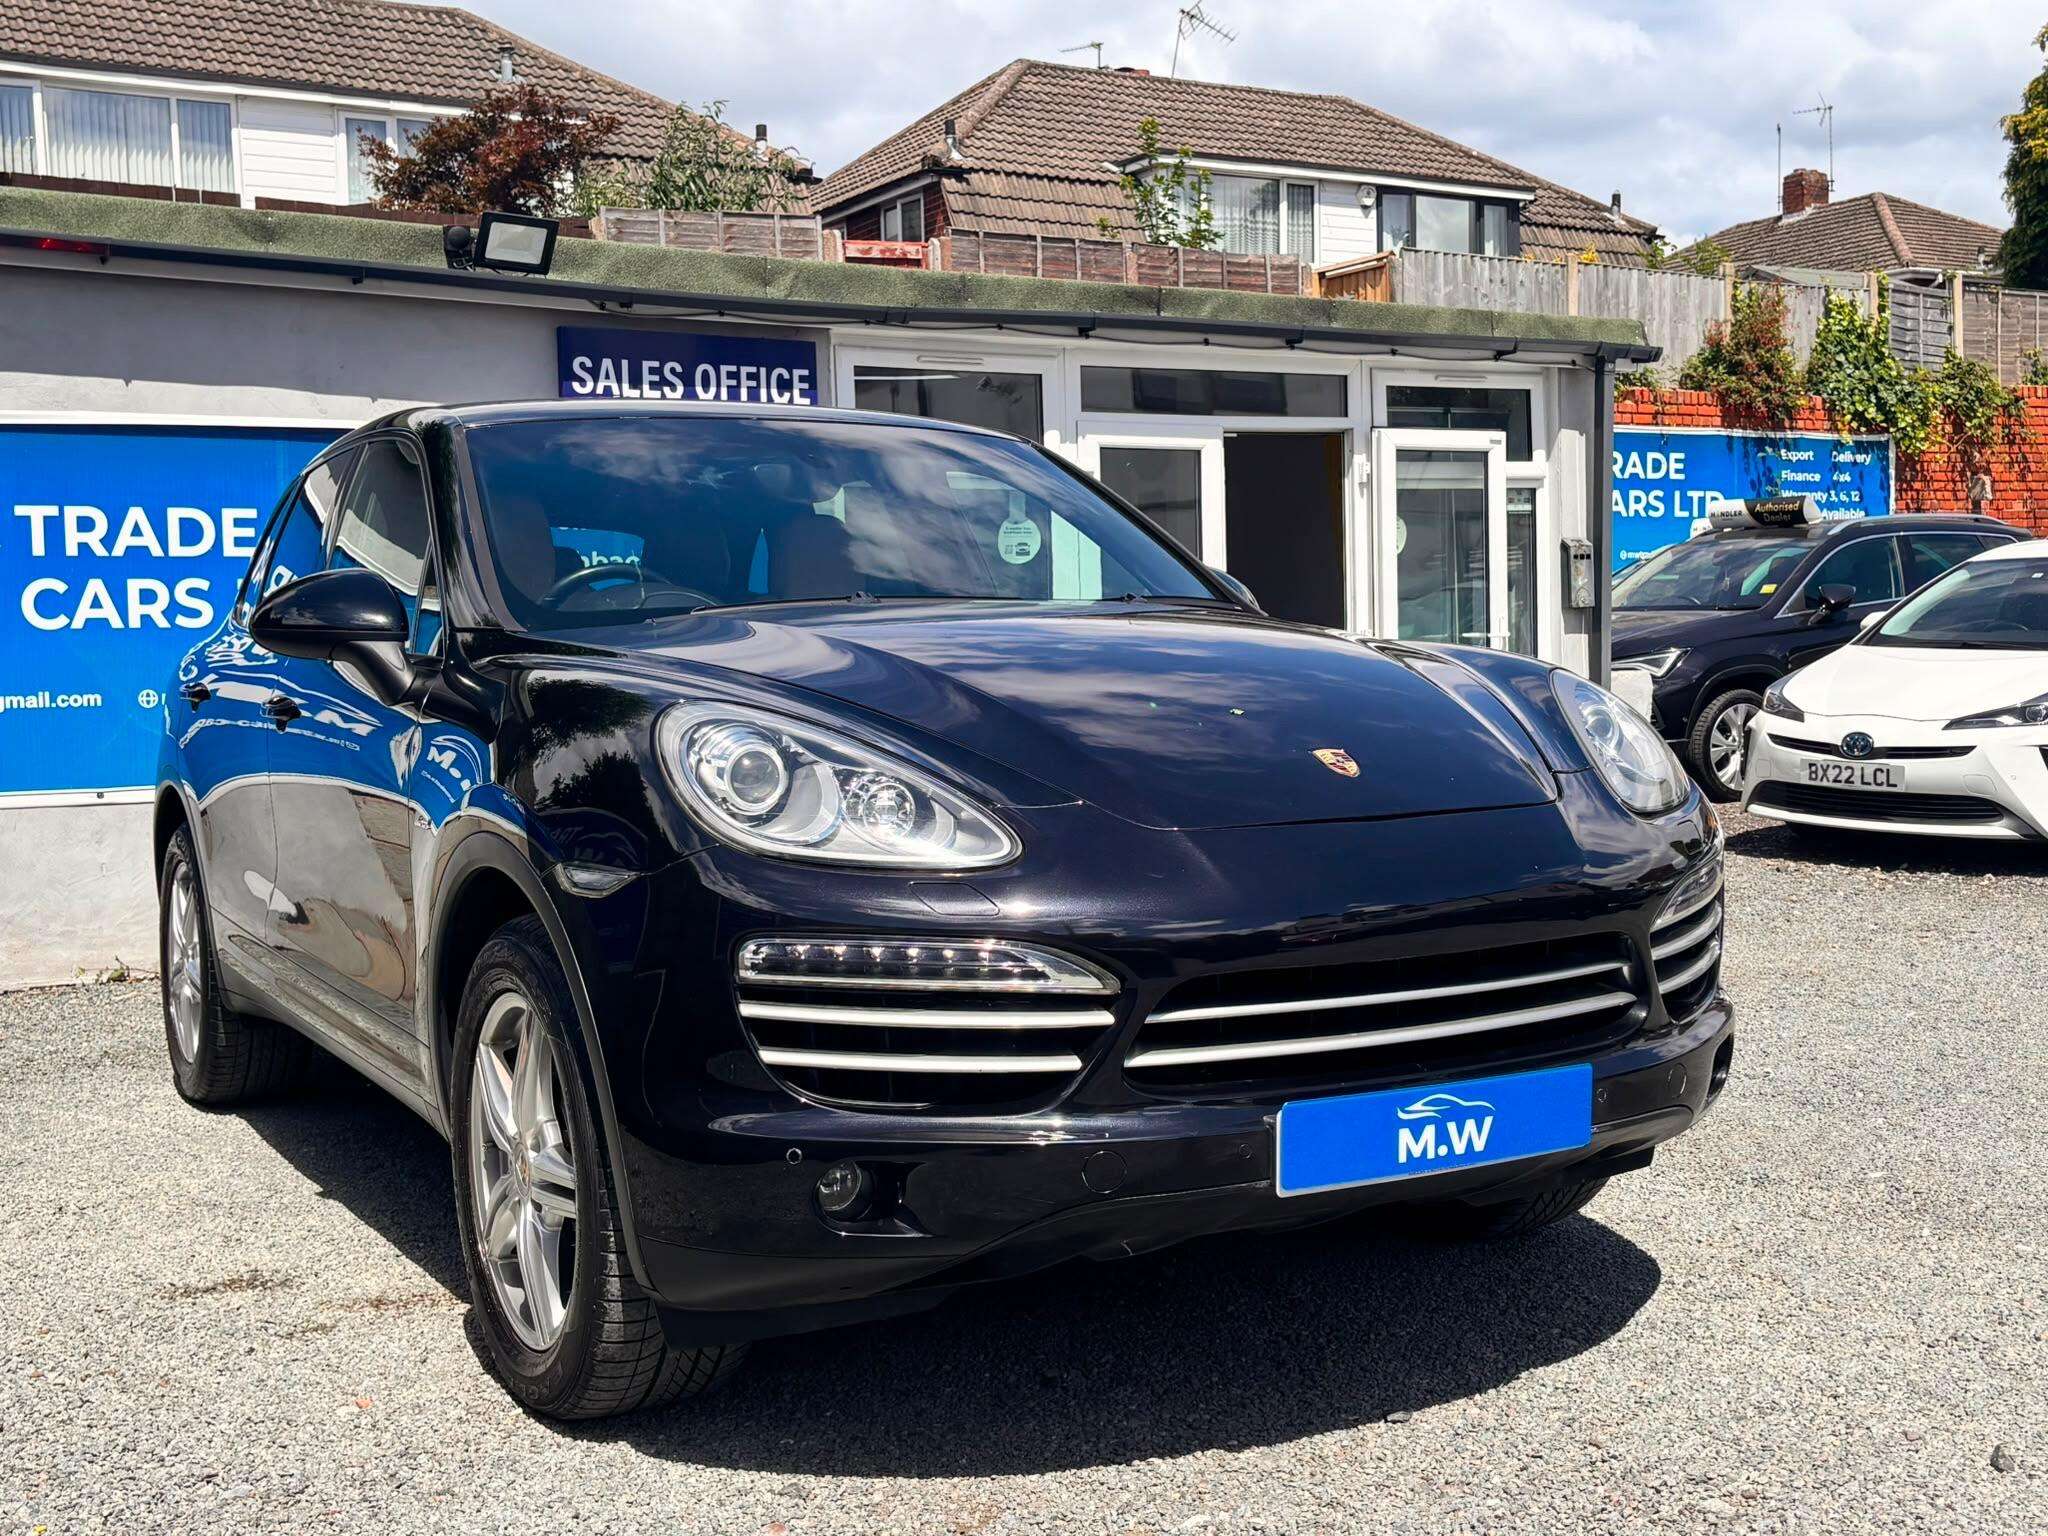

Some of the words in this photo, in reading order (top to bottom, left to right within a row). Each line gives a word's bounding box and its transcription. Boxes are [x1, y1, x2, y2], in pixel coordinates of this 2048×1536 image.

[571, 356, 685, 399] SALES
[694, 363, 811, 405] OFFICE
[1780, 449, 1814, 462] Export
[1831, 451, 1871, 465] Delivery
[1781, 470, 1821, 482] Finance
[1833, 472, 1851, 482] 4x4
[1851, 491, 1860, 502] 12
[1754, 501, 1800, 513] Authorised
[1821, 508, 1866, 520] Available
[1763, 513, 1792, 522] Dealer
[14, 504, 258, 558] TRADE
[20, 577, 215, 631] CARS
[1808, 762, 1855, 785] BX22
[1860, 766, 1898, 788] LCL
[1398, 1115, 1494, 1164] M.W
